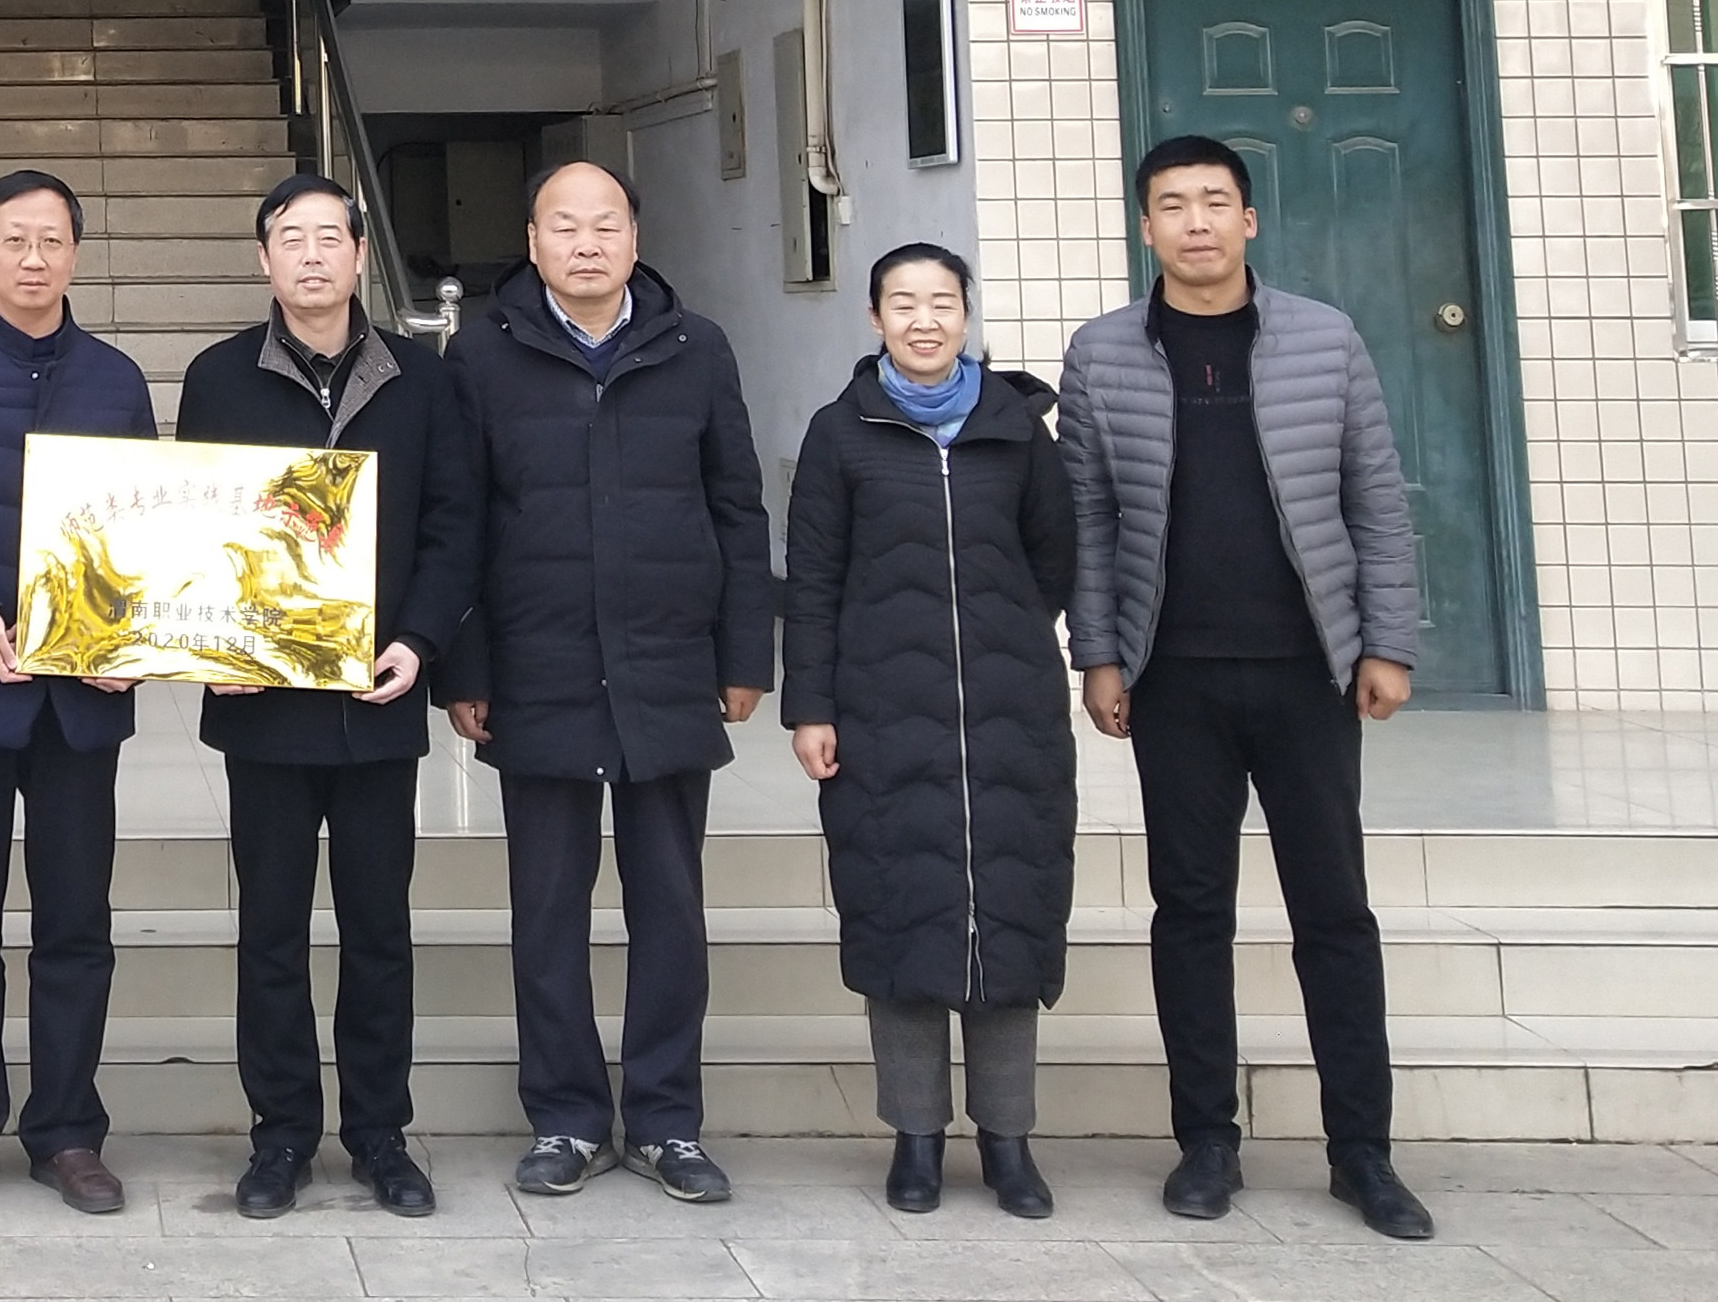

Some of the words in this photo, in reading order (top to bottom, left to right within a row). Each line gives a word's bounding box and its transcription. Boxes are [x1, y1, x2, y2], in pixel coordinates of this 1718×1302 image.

[1020, 7, 1032, 16] NO
[1035, 7, 1076, 16] SMOKING
[109, 600, 283, 628] 渭南职业技术学院
